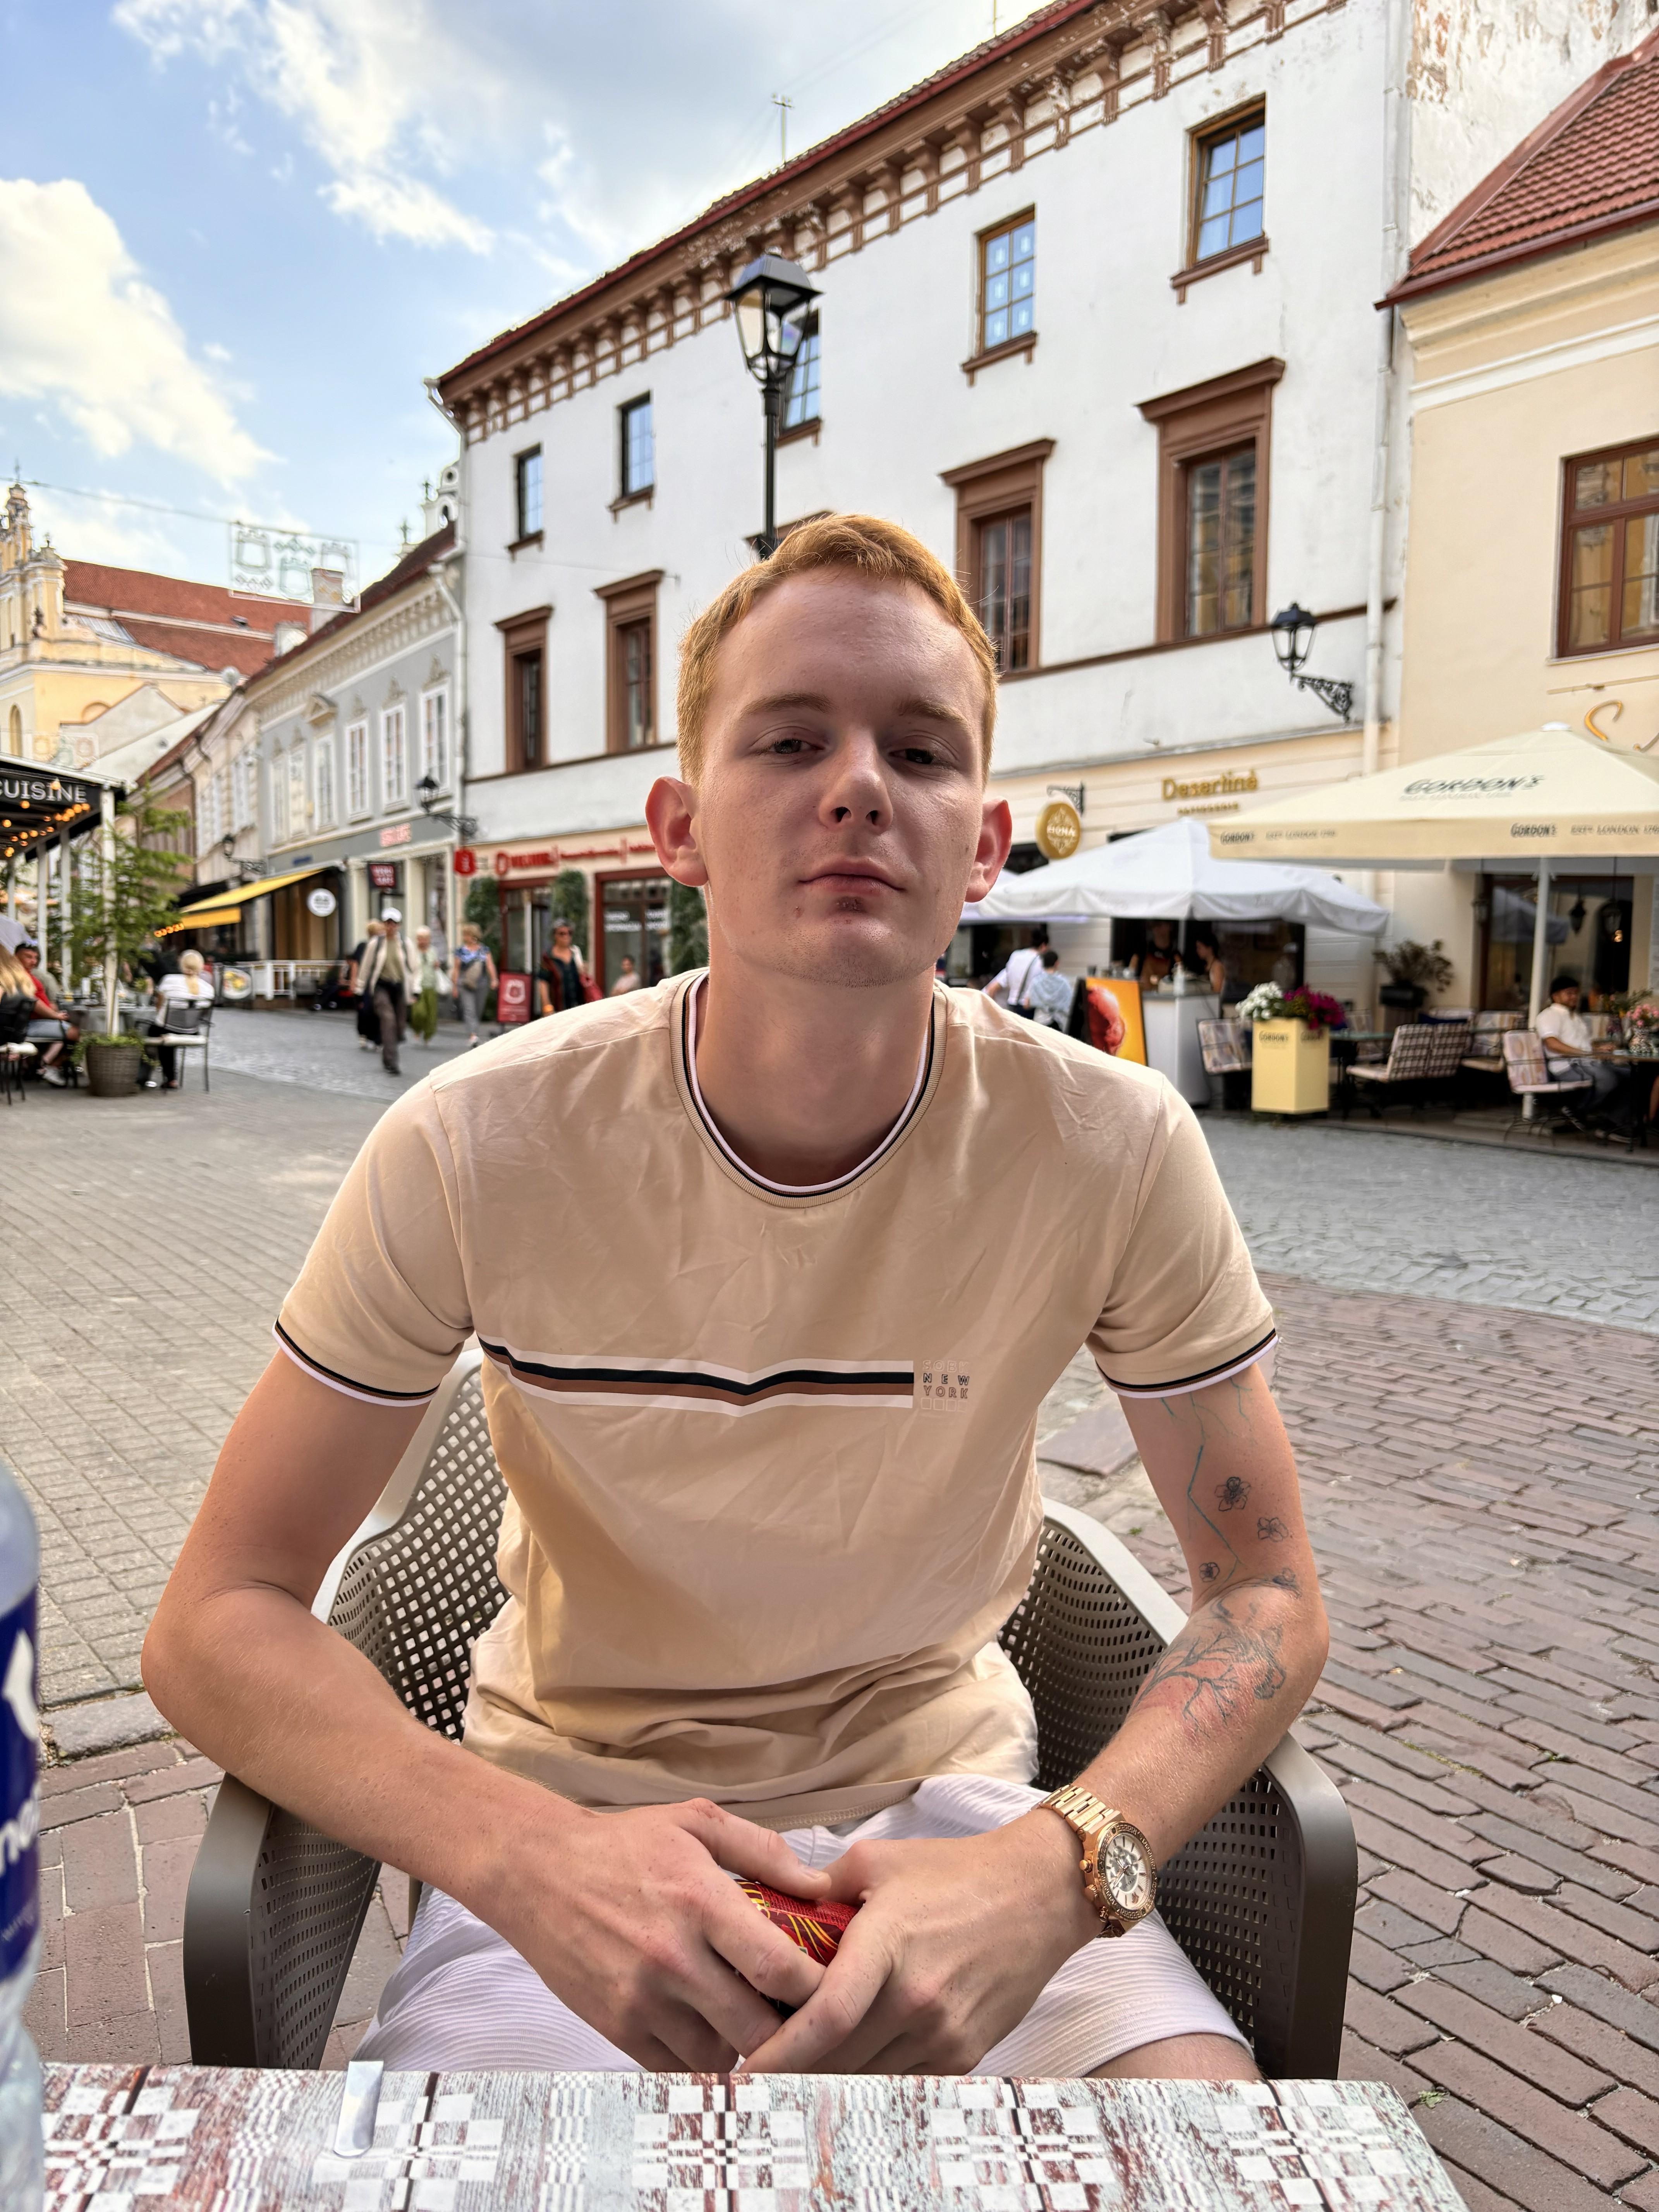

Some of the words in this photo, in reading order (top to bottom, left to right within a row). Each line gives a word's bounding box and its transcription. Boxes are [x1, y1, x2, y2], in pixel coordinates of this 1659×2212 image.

[0, 779, 88, 803] UISINE
[923, 1372, 970, 1386] NEW
[923, 1385, 969, 1399] YORK
